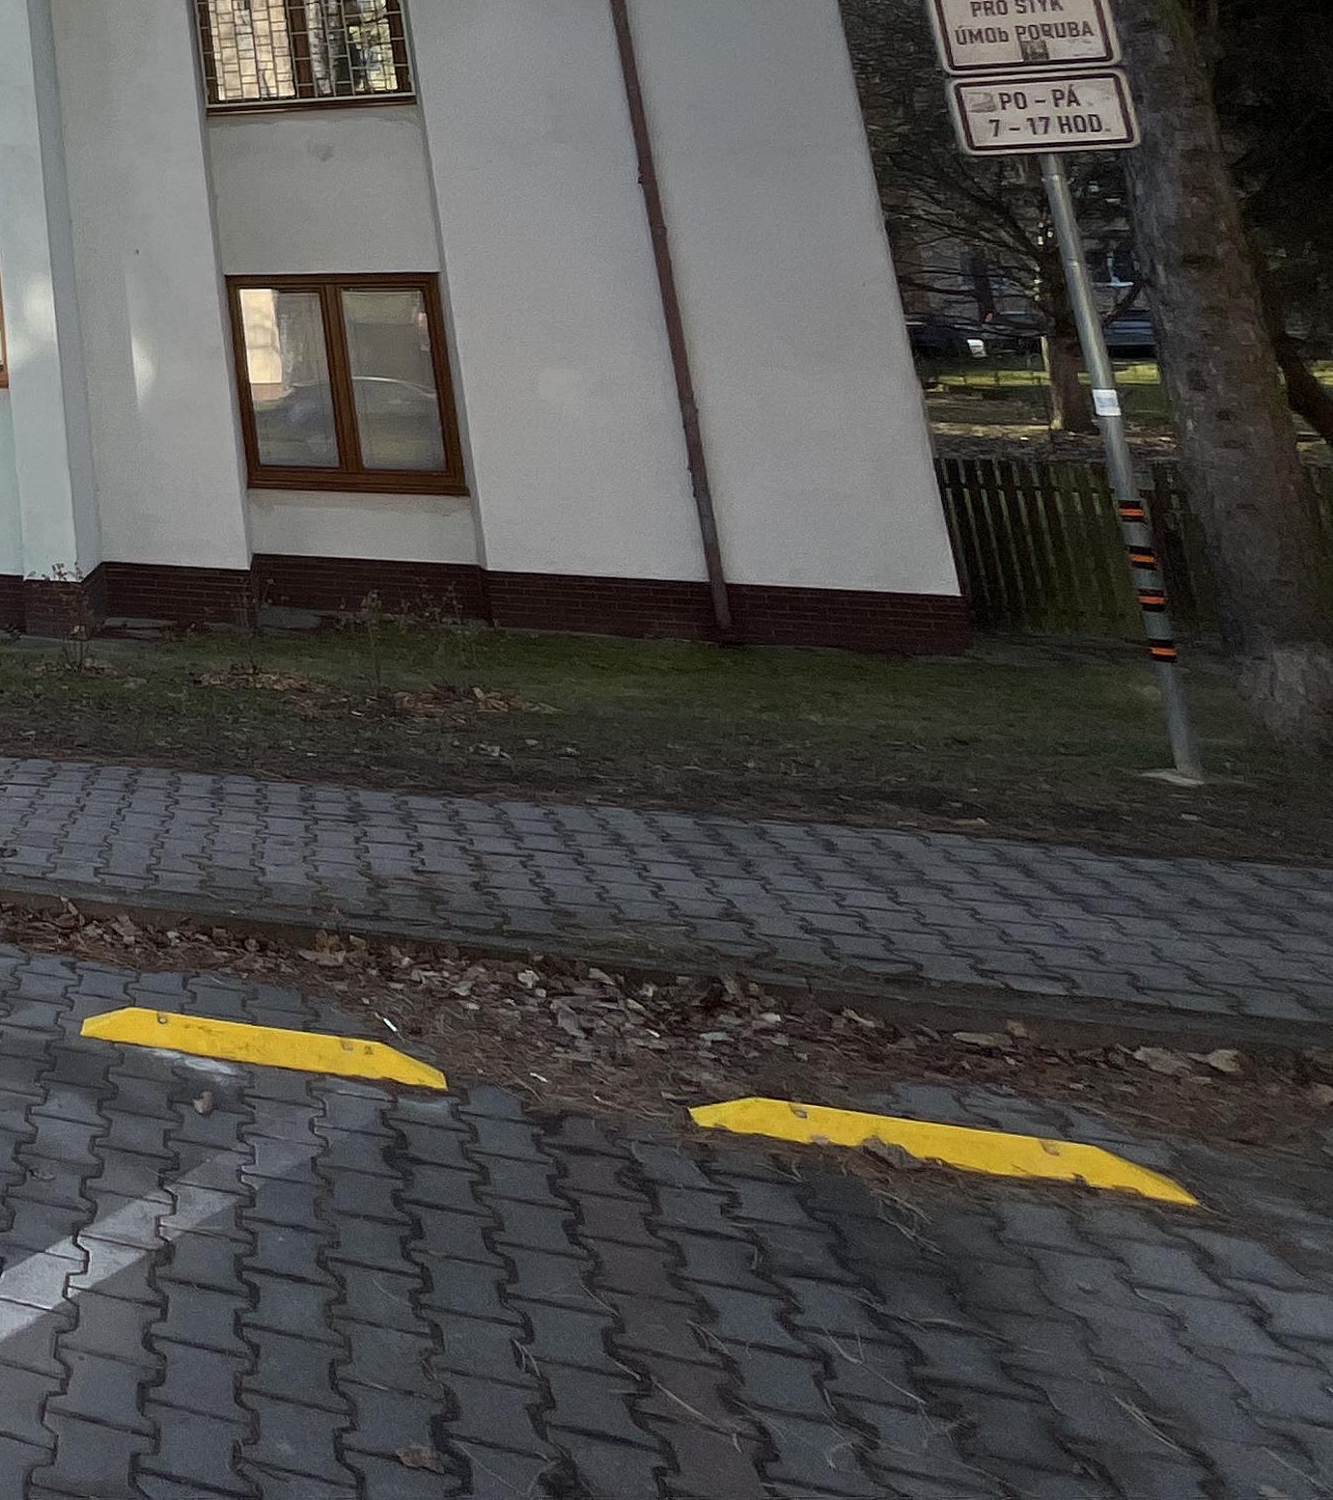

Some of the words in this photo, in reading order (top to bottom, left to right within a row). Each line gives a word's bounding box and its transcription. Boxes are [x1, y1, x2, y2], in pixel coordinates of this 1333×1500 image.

[970, 0, 1009, 17] PRO
[1014, 21, 1095, 43] PORUBA
[998, 91, 1028, 111] PO
[1051, 84, 1081, 108] PÁ
[988, 119, 1001, 138] 7
[1026, 116, 1051, 135] 17
